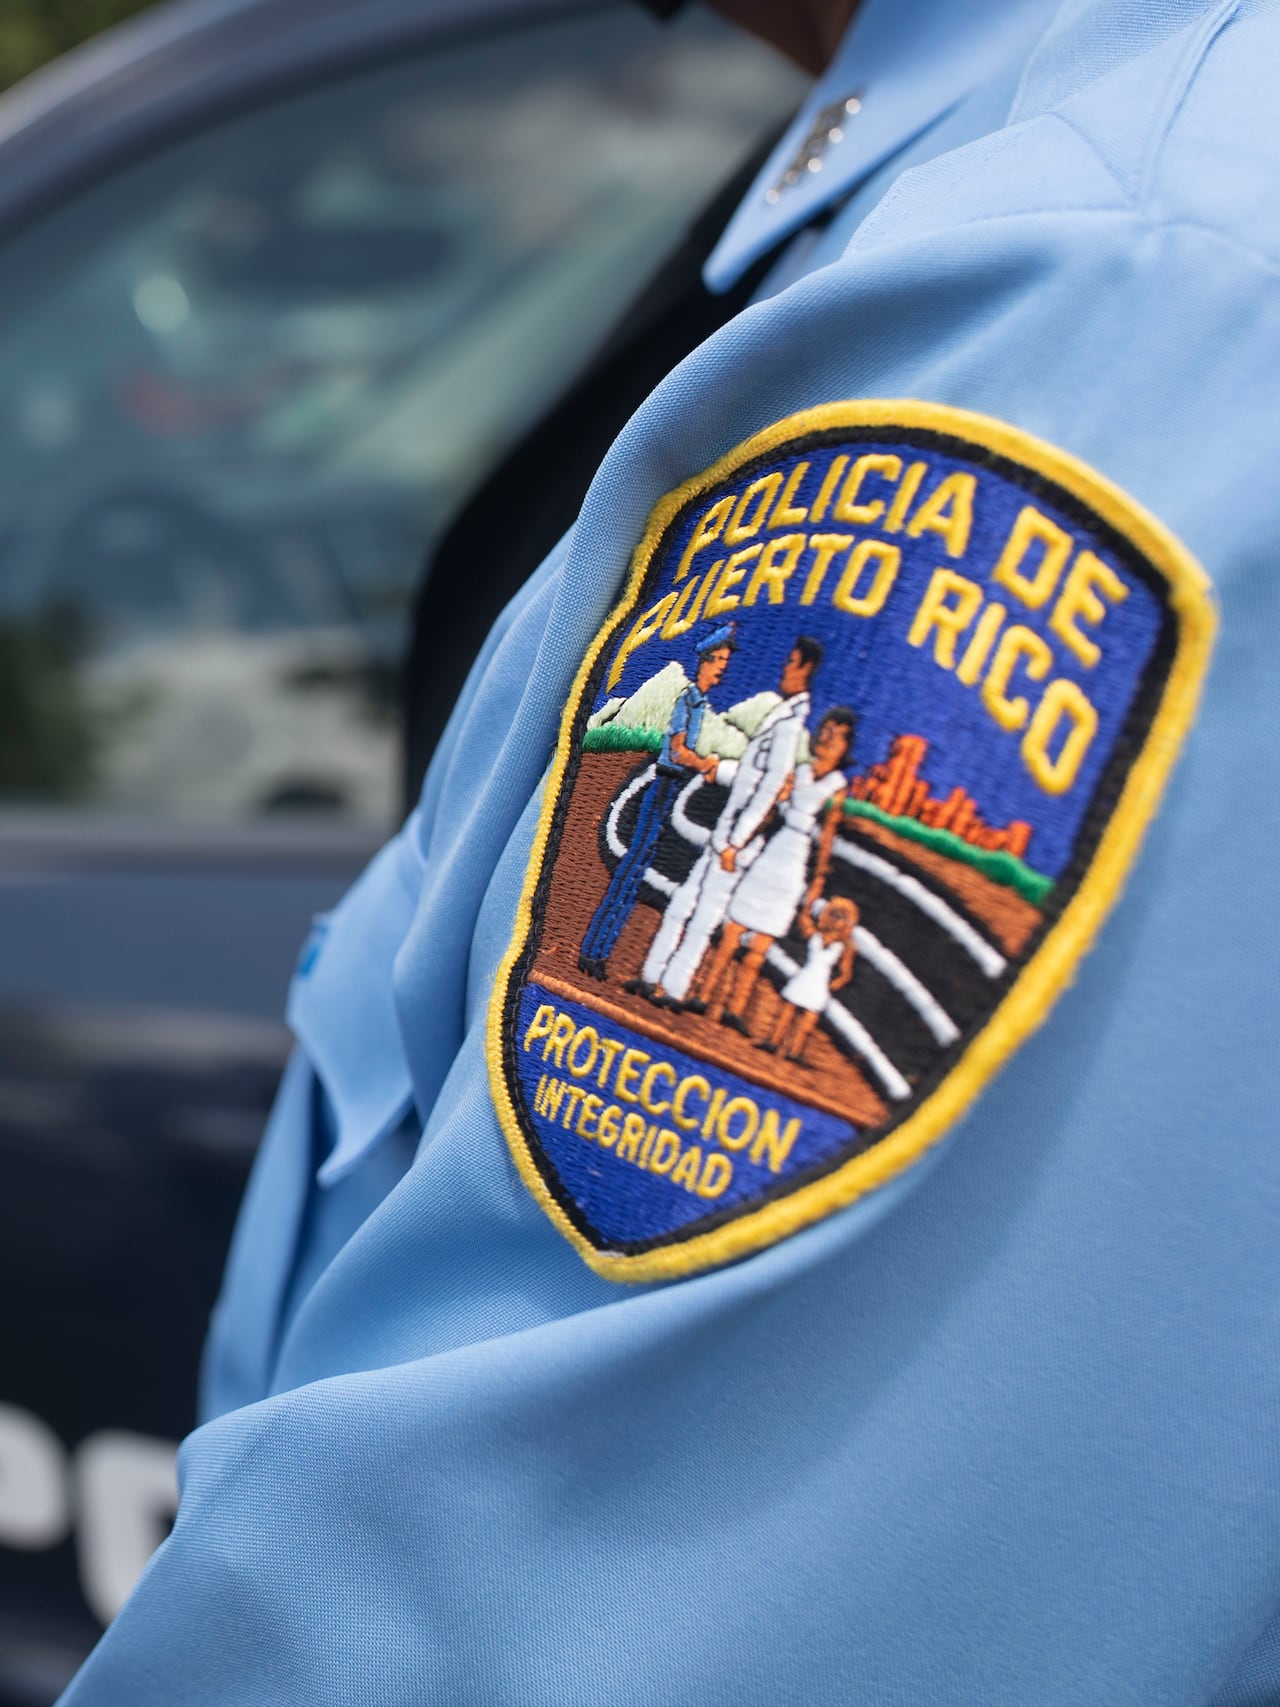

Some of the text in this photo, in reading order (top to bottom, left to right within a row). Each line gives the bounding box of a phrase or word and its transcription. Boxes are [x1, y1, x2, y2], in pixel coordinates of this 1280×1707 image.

[674, 453, 1128, 667] POLICIA DE
[607, 532, 1098, 794] PUERTO RICO
[523, 1004, 802, 1173] PROTECCION
[533, 1074, 733, 1199] INTEGRIDAD
